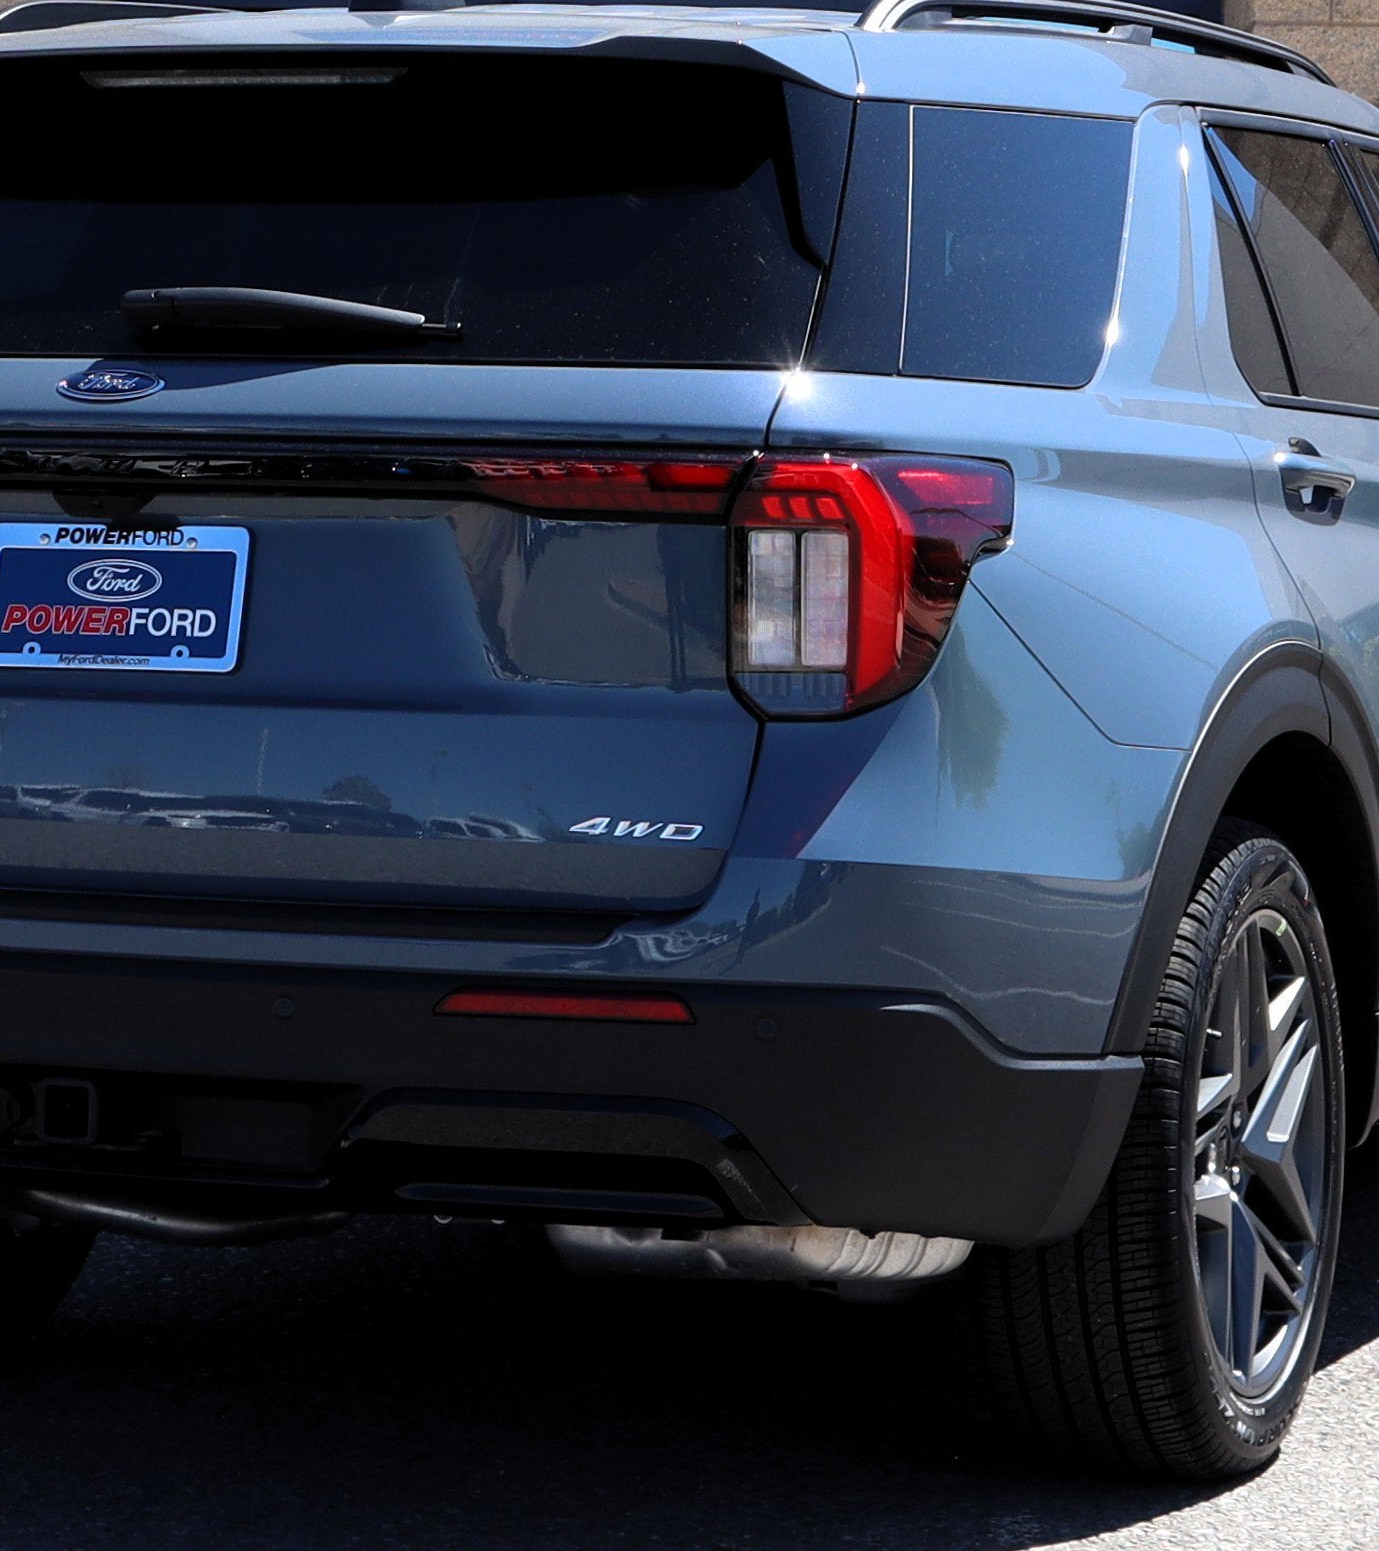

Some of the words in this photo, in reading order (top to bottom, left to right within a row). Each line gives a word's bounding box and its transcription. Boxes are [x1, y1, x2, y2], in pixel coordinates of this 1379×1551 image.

[77, 373, 140, 390] Ford
[86, 565, 144, 593] Ford
[1, 603, 217, 638] POWERFORD
[568, 816, 705, 841] 4WD
